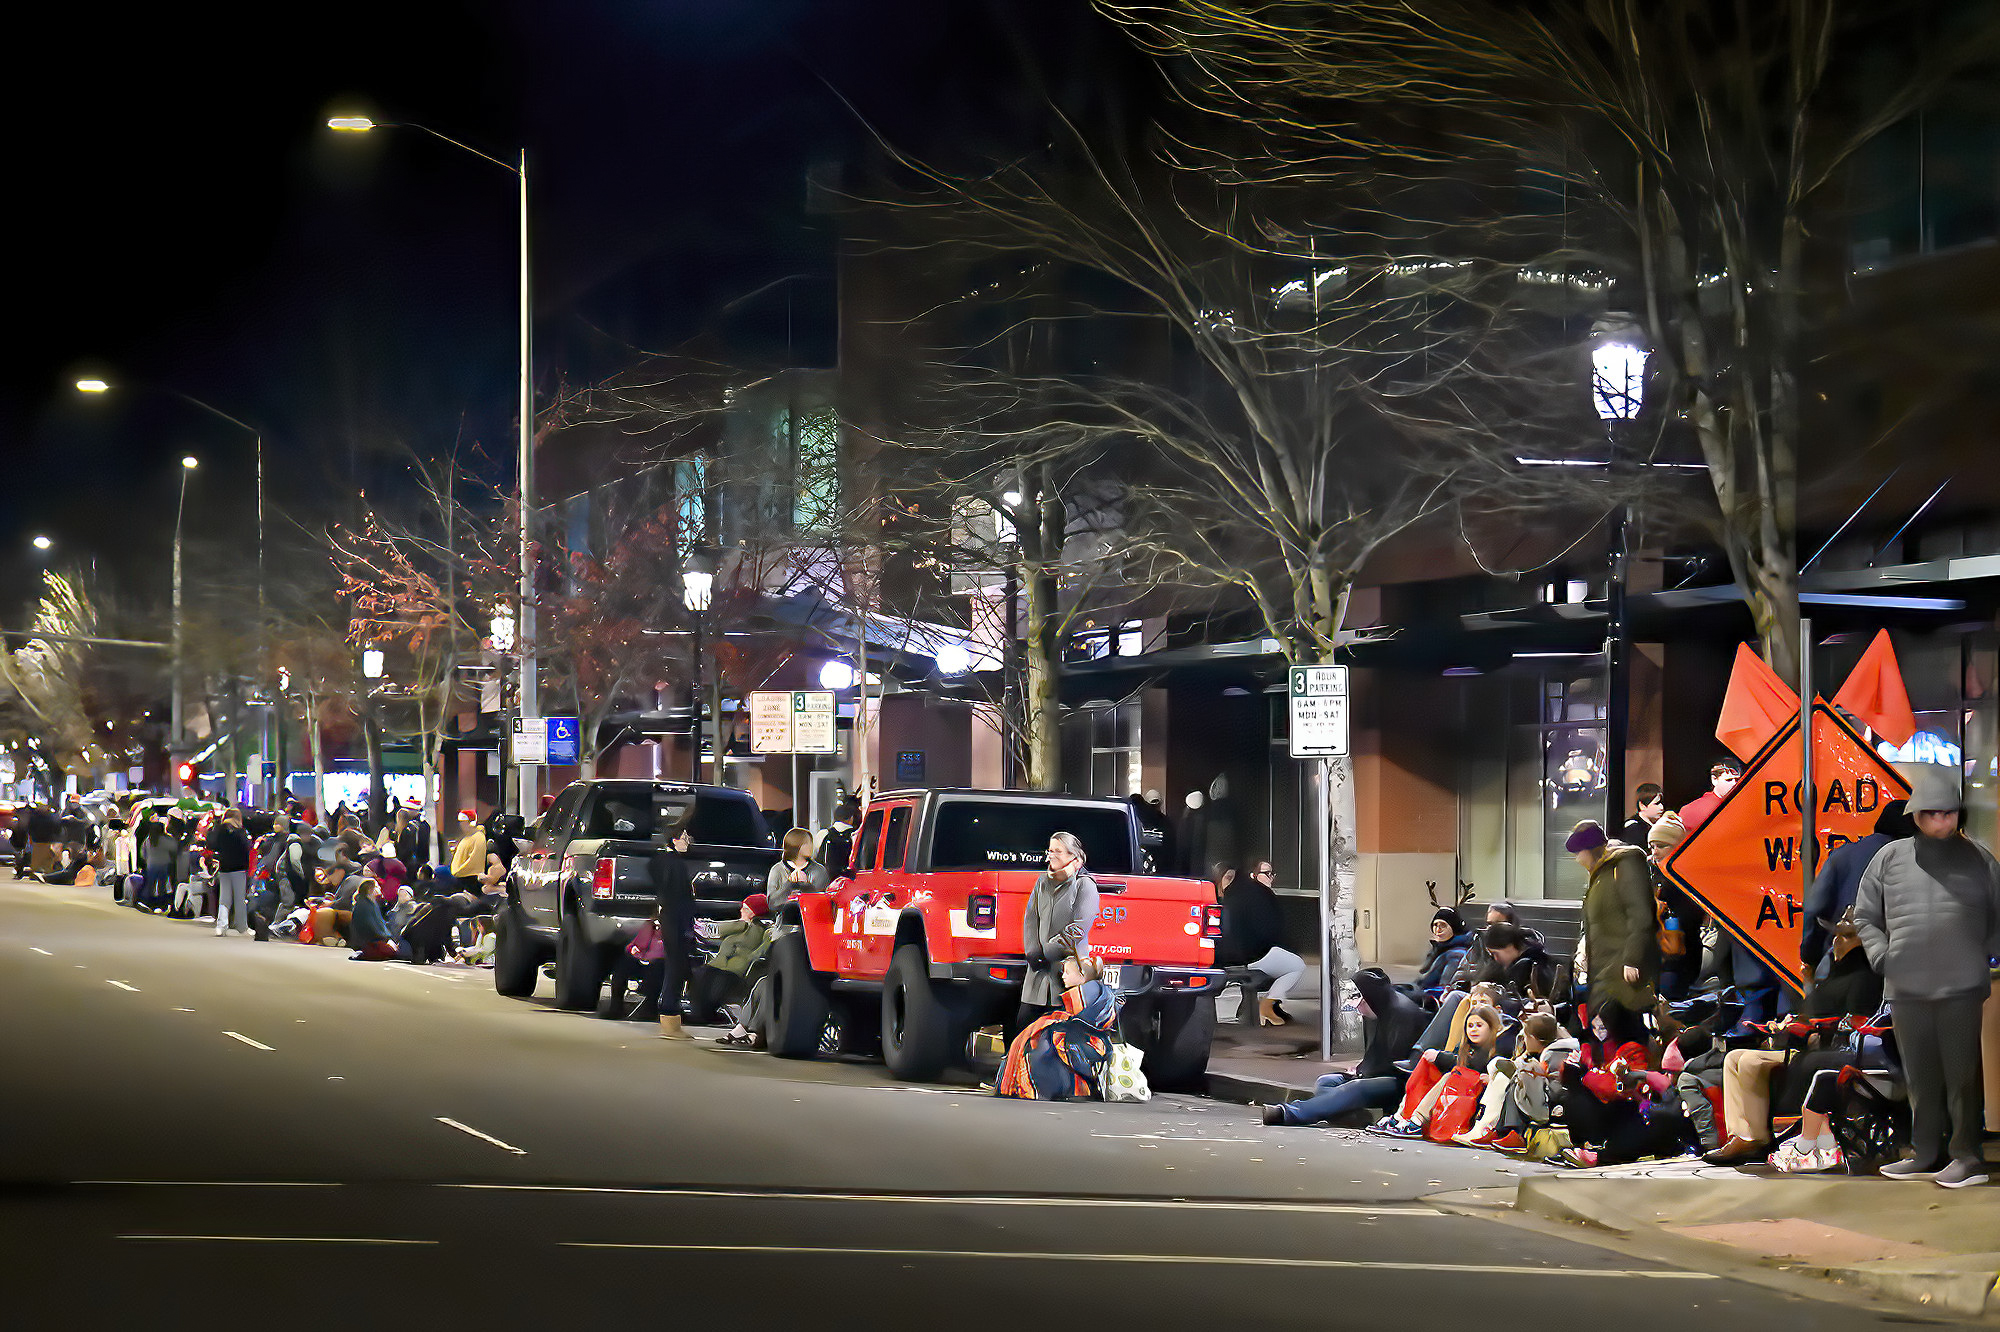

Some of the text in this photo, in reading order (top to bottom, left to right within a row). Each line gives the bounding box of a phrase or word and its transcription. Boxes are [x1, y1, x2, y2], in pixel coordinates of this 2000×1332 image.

[1316, 672, 1337, 681] HOUR
[1295, 672, 1305, 694] 3
[1309, 684, 1343, 693] PARKING
[796, 695, 805, 710] 3
[1298, 711, 1317, 719] MON
[1324, 711, 1339, 719] SAT
[515, 720, 521, 731] 3
[1765, 778, 1878, 815] ROAD
[986, 850, 1017, 861] Who's
[1020, 852, 1043, 862] Your
[1102, 906, 1128, 923] ep
